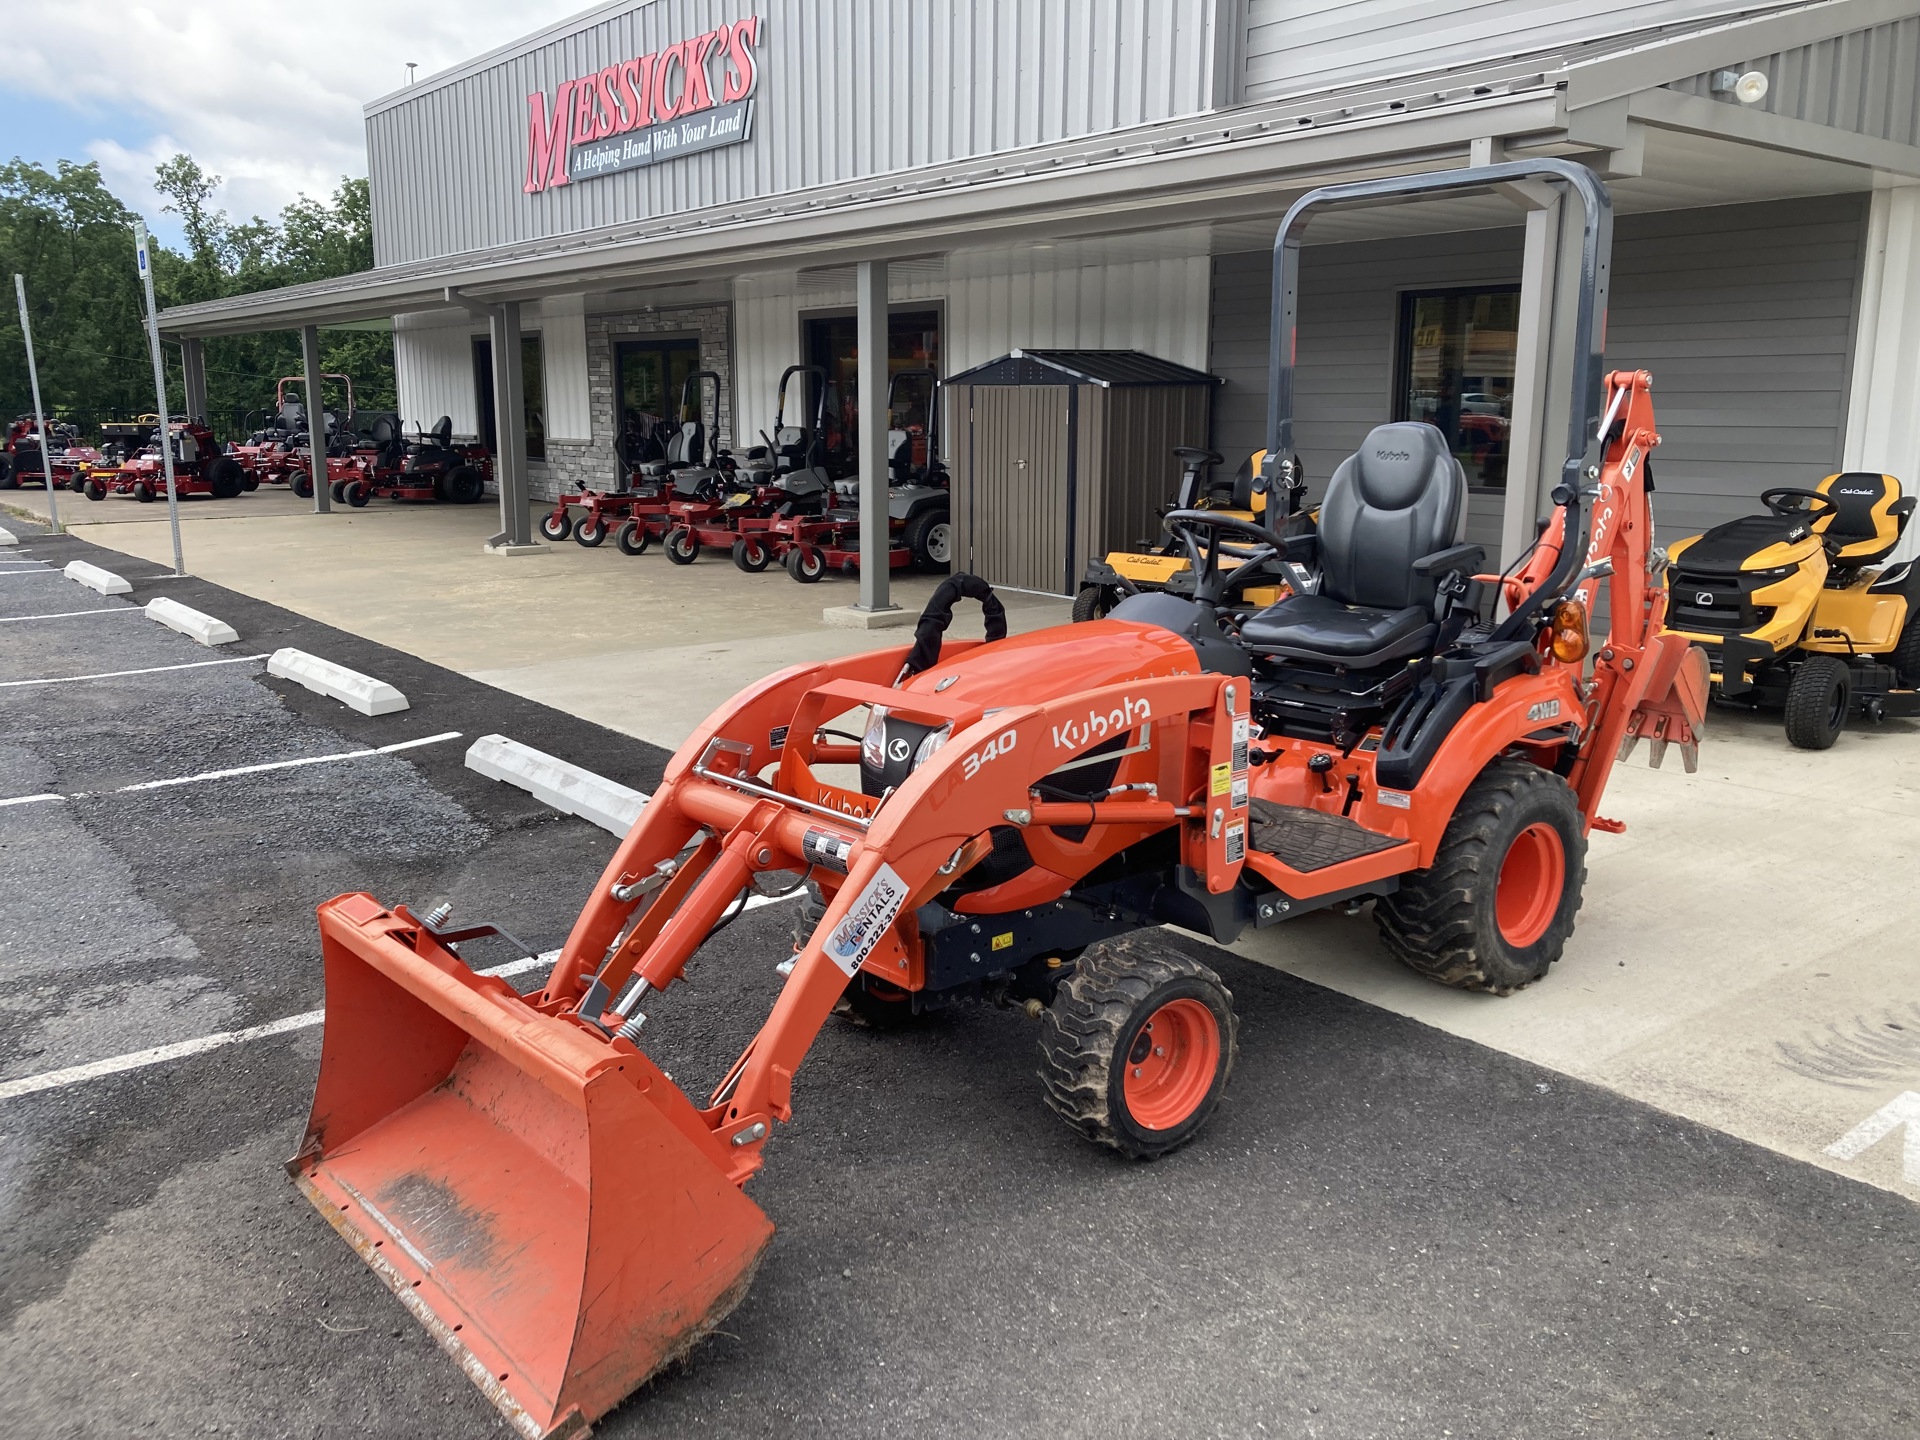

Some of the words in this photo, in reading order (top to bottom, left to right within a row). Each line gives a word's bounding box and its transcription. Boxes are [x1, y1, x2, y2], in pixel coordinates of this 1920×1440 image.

[523, 16, 759, 194] MESSICK'S
[573, 149, 582, 173] A
[584, 145, 620, 172] Helping
[622, 134, 651, 160] Hand
[653, 124, 678, 153] With
[681, 122, 707, 145] Your
[709, 108, 742, 137] Land
[1376, 450, 1409, 461] Kubota
[1140, 557, 1163, 566] Cadet
[1052, 696, 1151, 750] Kubota
[1527, 699, 1560, 721] 4WD
[818, 788, 871, 819] Kubot
[835, 878, 889, 948] MESSICK'S
